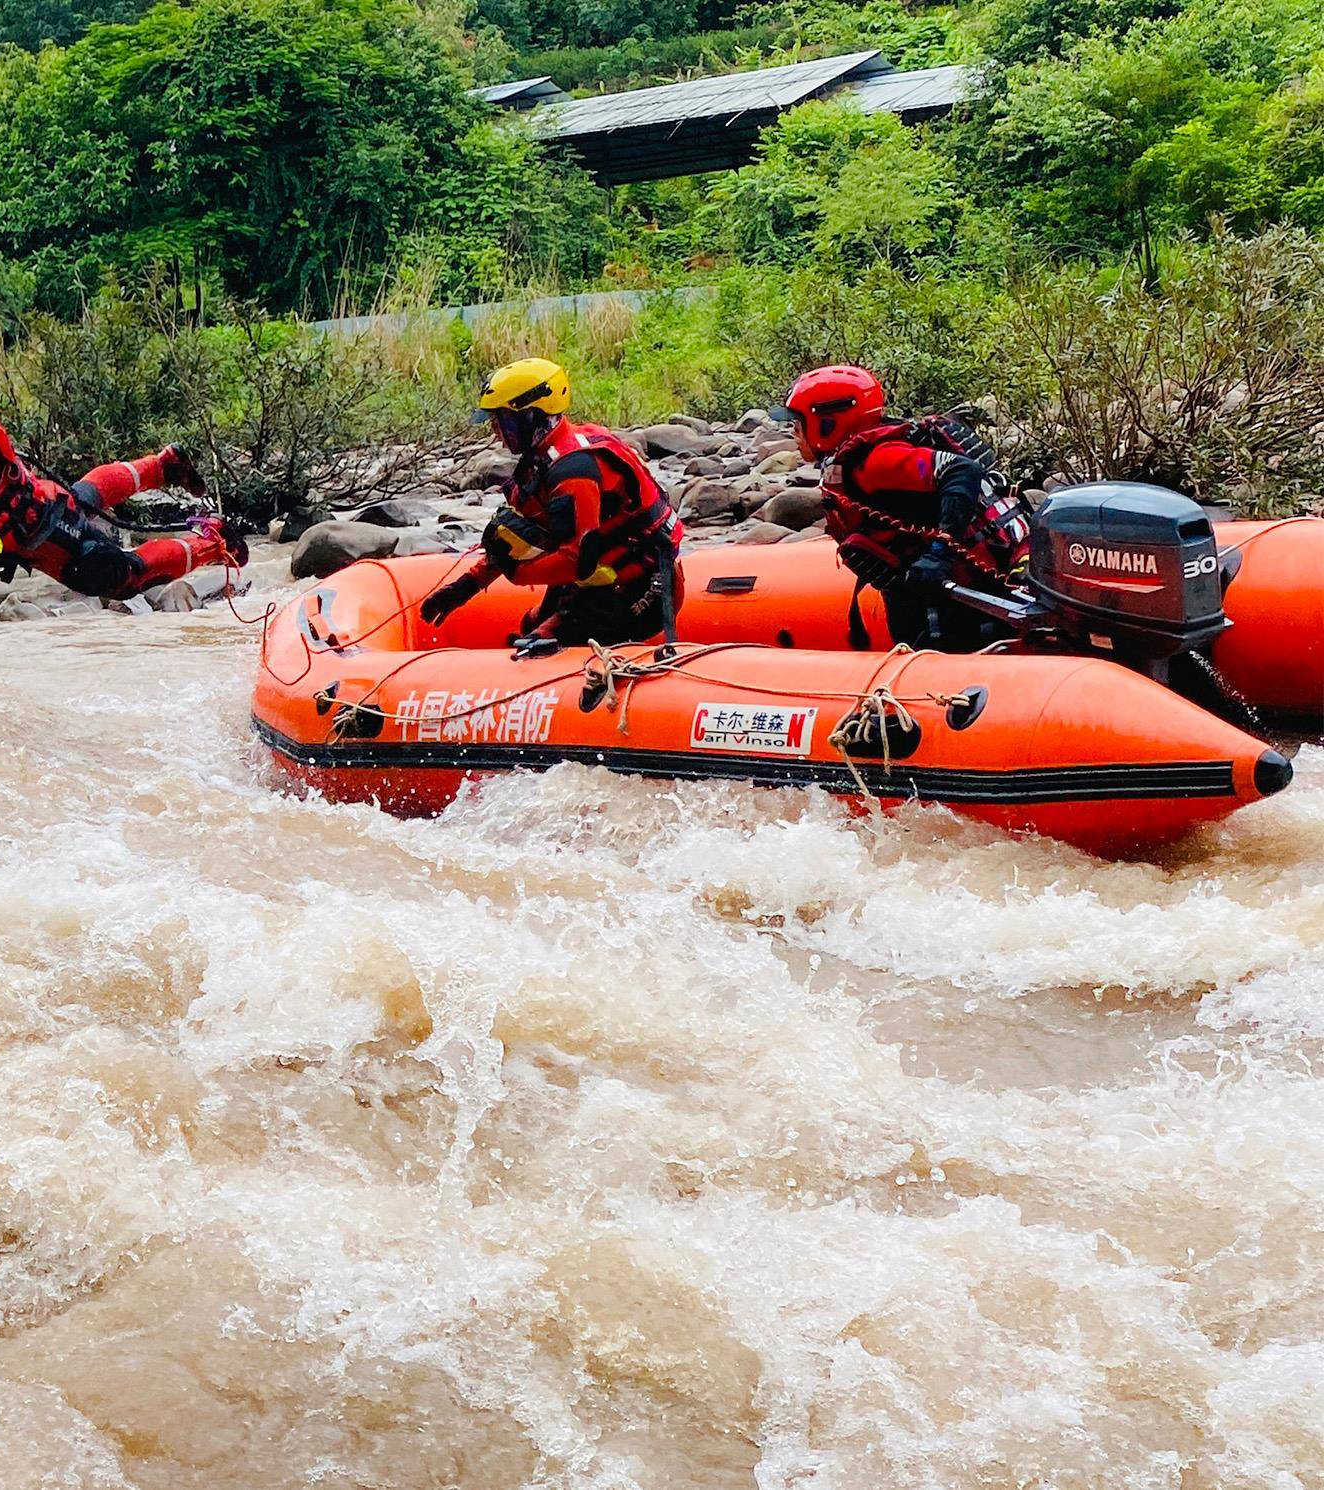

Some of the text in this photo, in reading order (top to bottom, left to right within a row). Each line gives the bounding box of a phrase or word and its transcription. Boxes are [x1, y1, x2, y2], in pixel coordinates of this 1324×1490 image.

[1086, 546, 1158, 574] YAMAHA
[1184, 555, 1217, 579] 30
[394, 687, 560, 743] 中国森林消防
